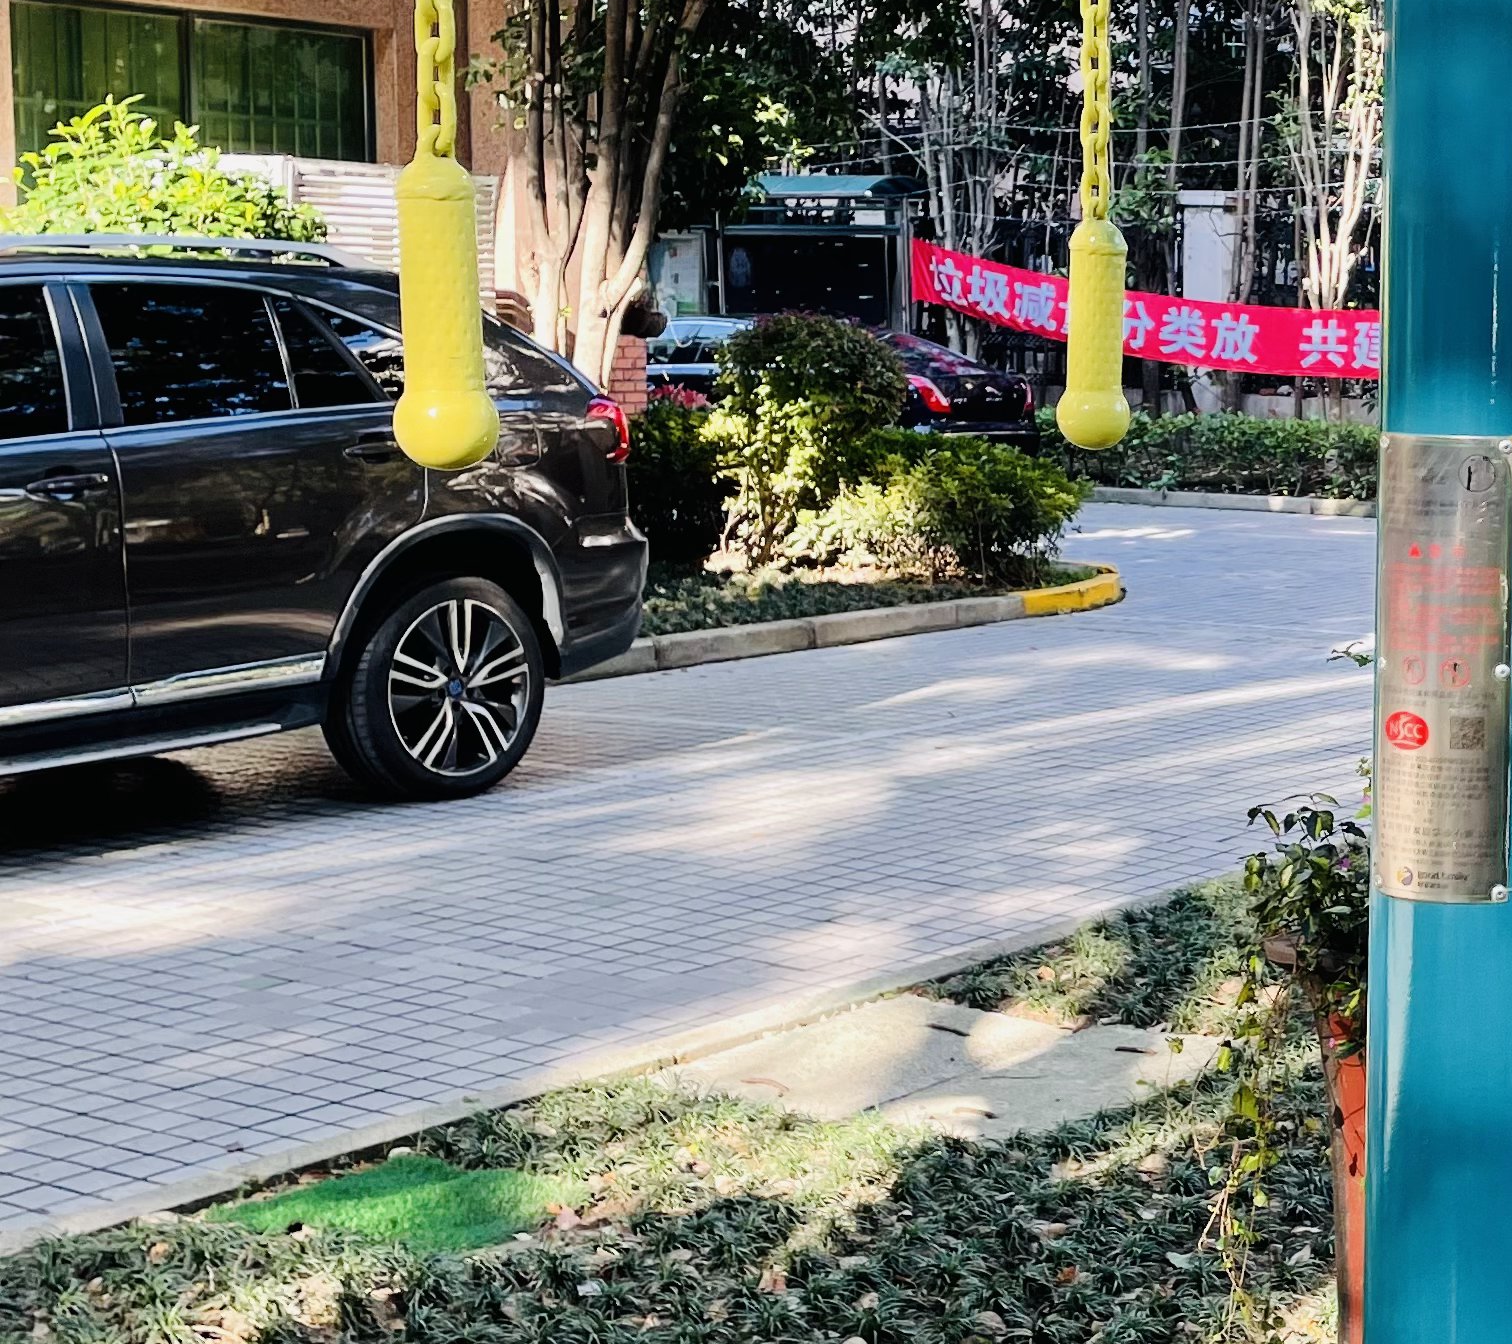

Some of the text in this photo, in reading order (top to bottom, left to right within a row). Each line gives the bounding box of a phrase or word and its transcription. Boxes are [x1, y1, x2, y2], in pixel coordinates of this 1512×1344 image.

[929, 255, 1260, 364] 垃圾减分类放
[1388, 715, 1423, 741] NSCC
